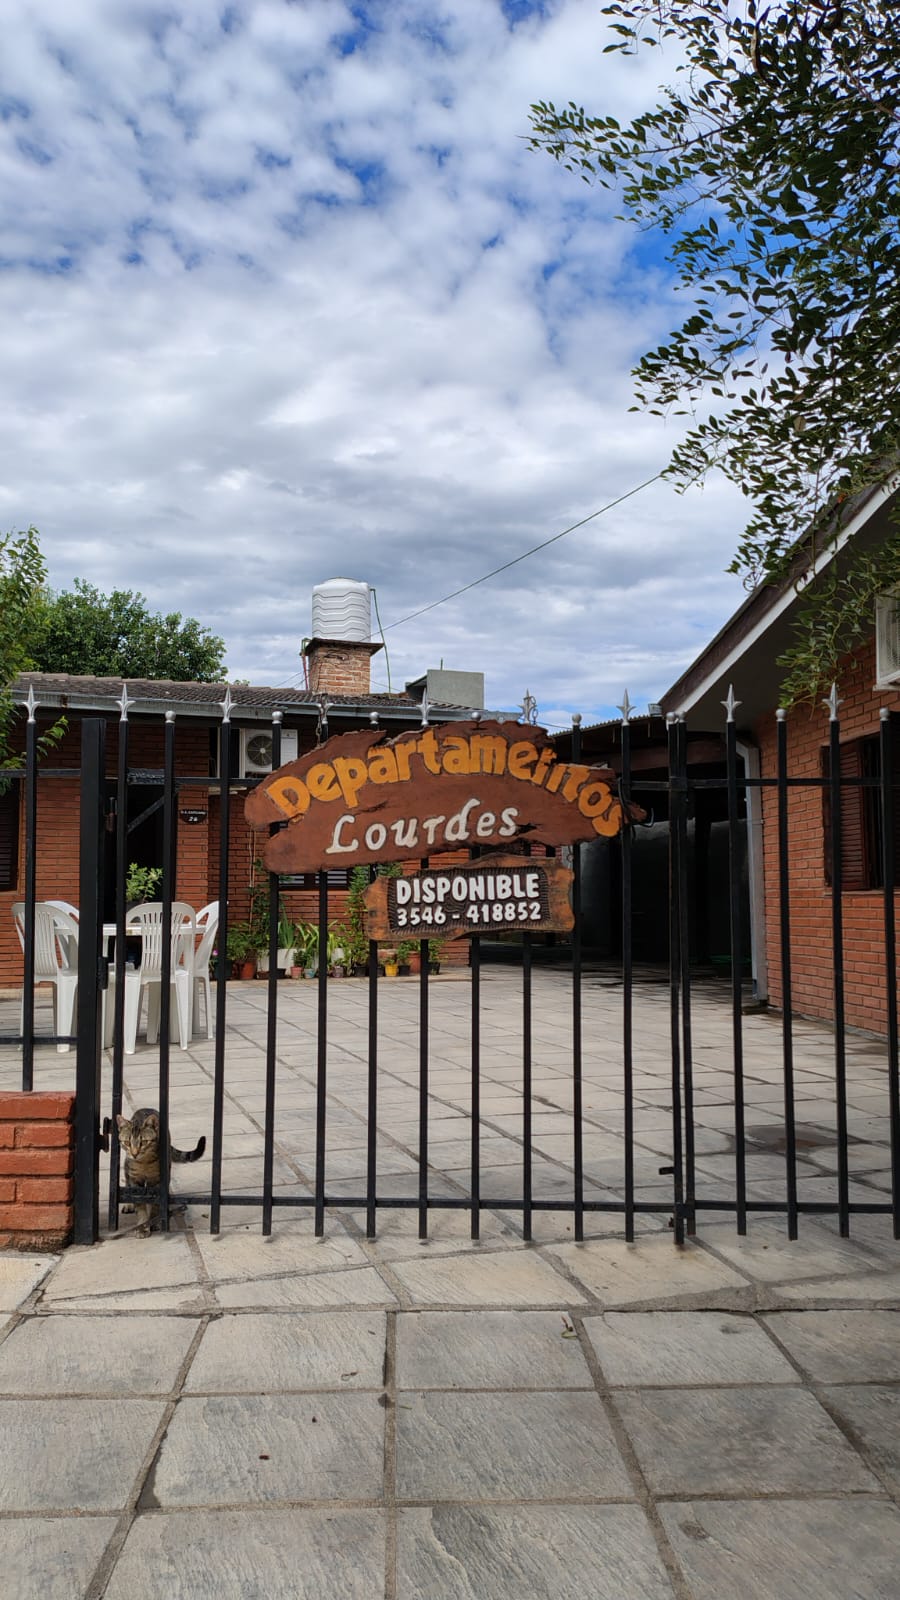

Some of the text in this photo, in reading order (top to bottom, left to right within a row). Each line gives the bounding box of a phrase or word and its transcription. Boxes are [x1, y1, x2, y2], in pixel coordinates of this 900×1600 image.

[265, 728, 622, 837] Departamentos
[326, 798, 518, 854] Lourdes
[396, 873, 540, 905] DISPONIBLE
